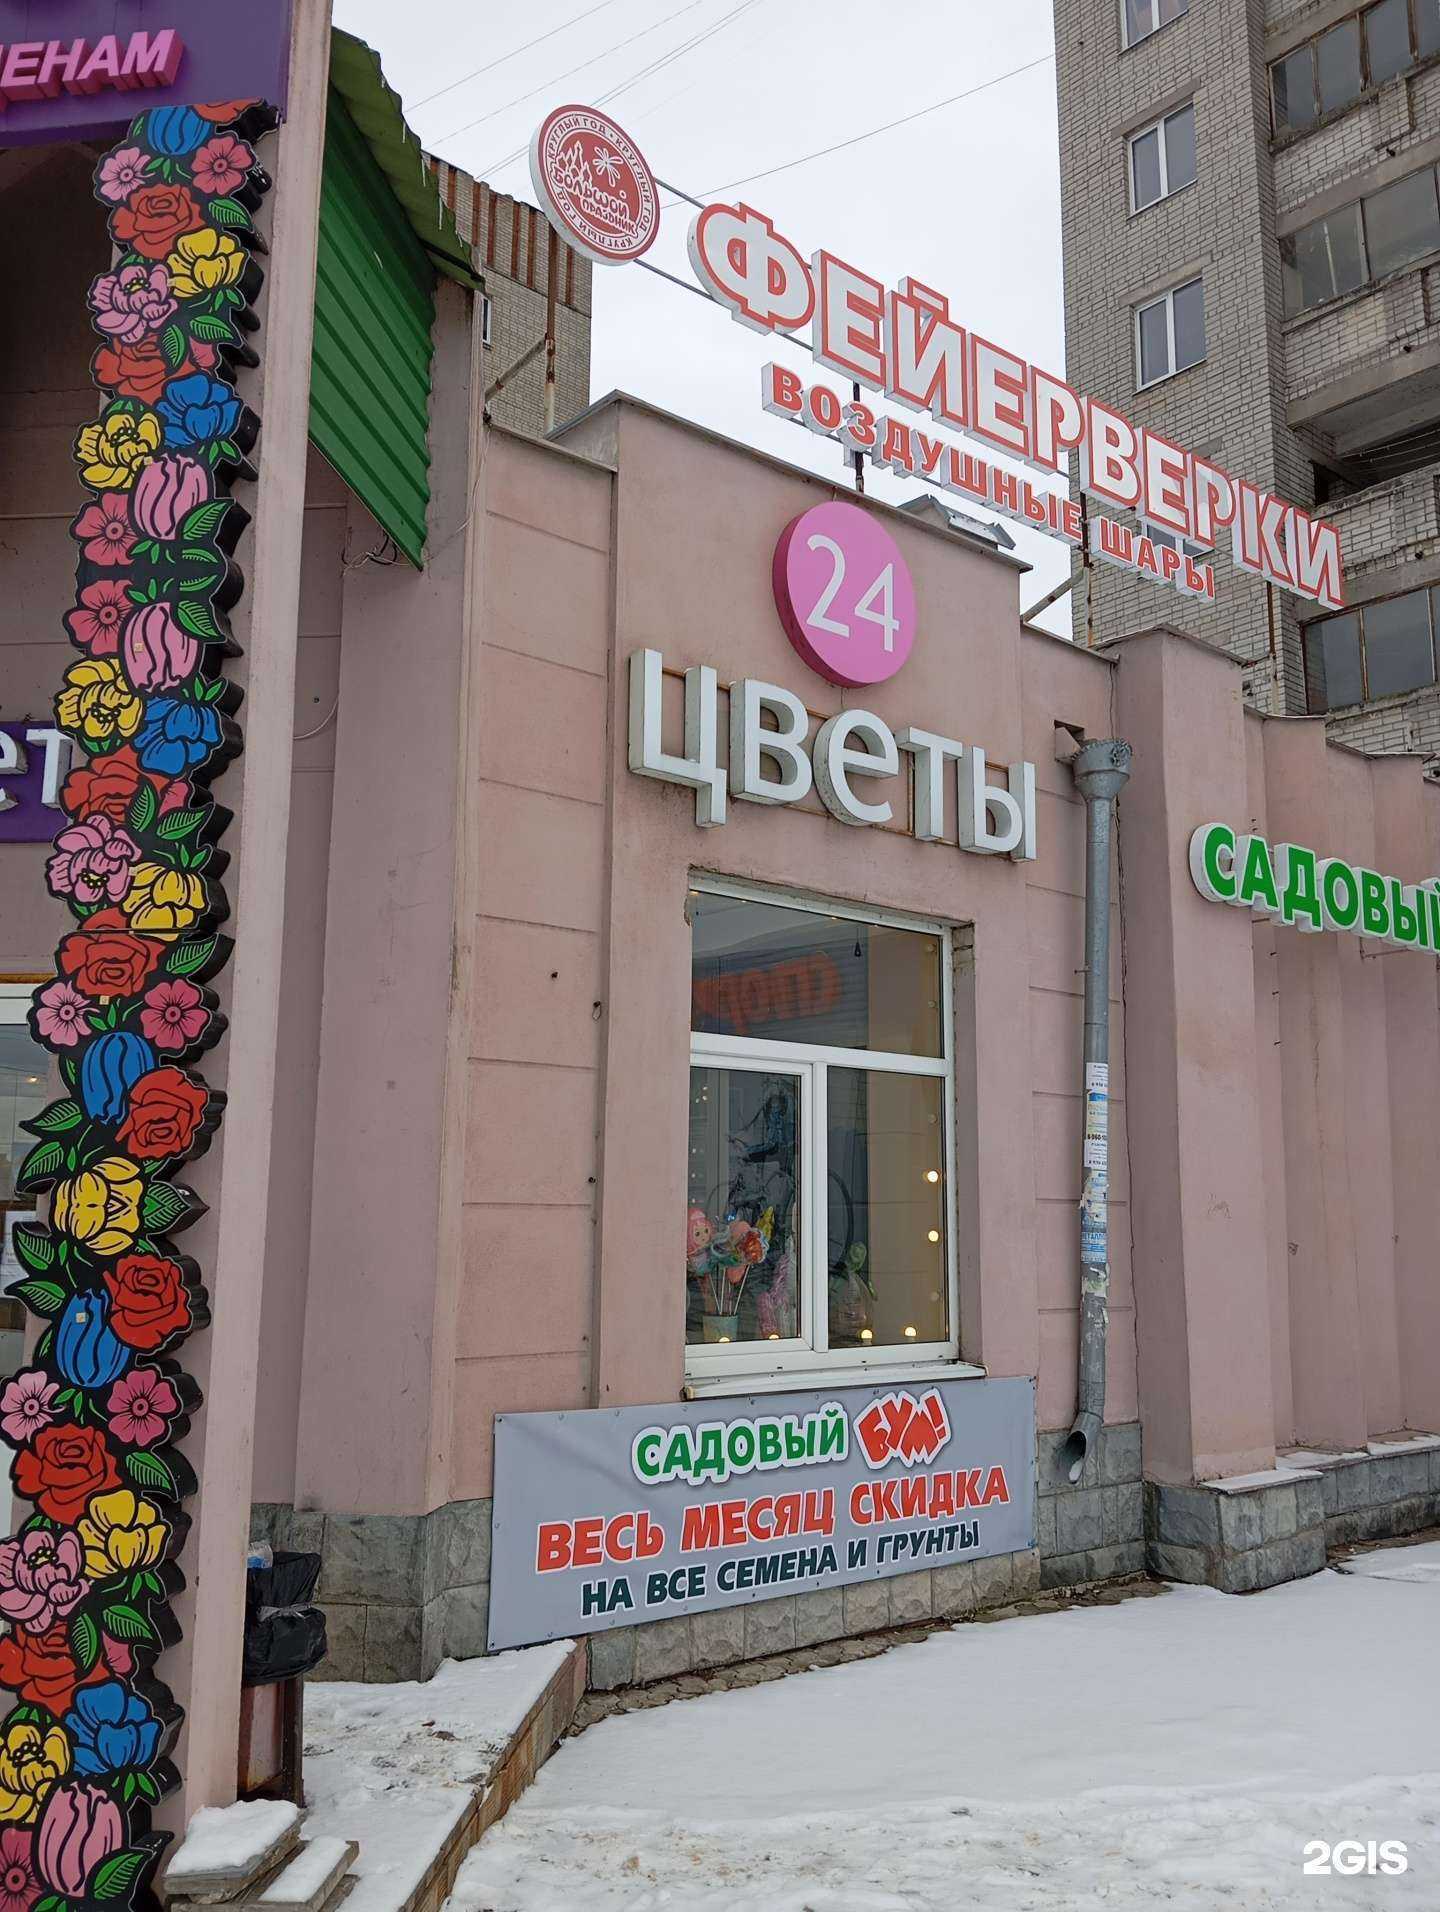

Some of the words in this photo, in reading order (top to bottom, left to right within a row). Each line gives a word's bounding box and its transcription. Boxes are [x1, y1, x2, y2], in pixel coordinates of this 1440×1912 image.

[0, 29, 184, 98] ЕНАМ
[547, 116, 580, 160] КРУГЛЫЙ
[582, 117, 607, 135] ГОД
[615, 138, 651, 202] КРУГЛЫЙ
[639, 206, 652, 232] ГОД
[581, 199, 637, 236] ПРАЗДНИК
[690, 202, 1344, 608] ФЕЙЕРВЕРКИ
[766, 362, 1083, 543] ВОЗДУШНЫЕ
[1098, 516, 1215, 600] ШАРЫ
[807, 534, 899, 652] 24
[637, 1409, 845, 1477] САДОВЫЙ
[857, 1394, 947, 1462] БУМ!
[537, 1512, 664, 1572] ВЕСЬ
[681, 1489, 834, 1551] МЕСЯЦ
[850, 1466, 1010, 1525] СКИДКА
[582, 1578, 634, 1616] НА
[646, 1566, 706, 1605] ВСЕ
[717, 1545, 838, 1592] СЕМЕНА
[847, 1540, 867, 1569] И
[876, 1521, 980, 1564] ГРУНТЫ
